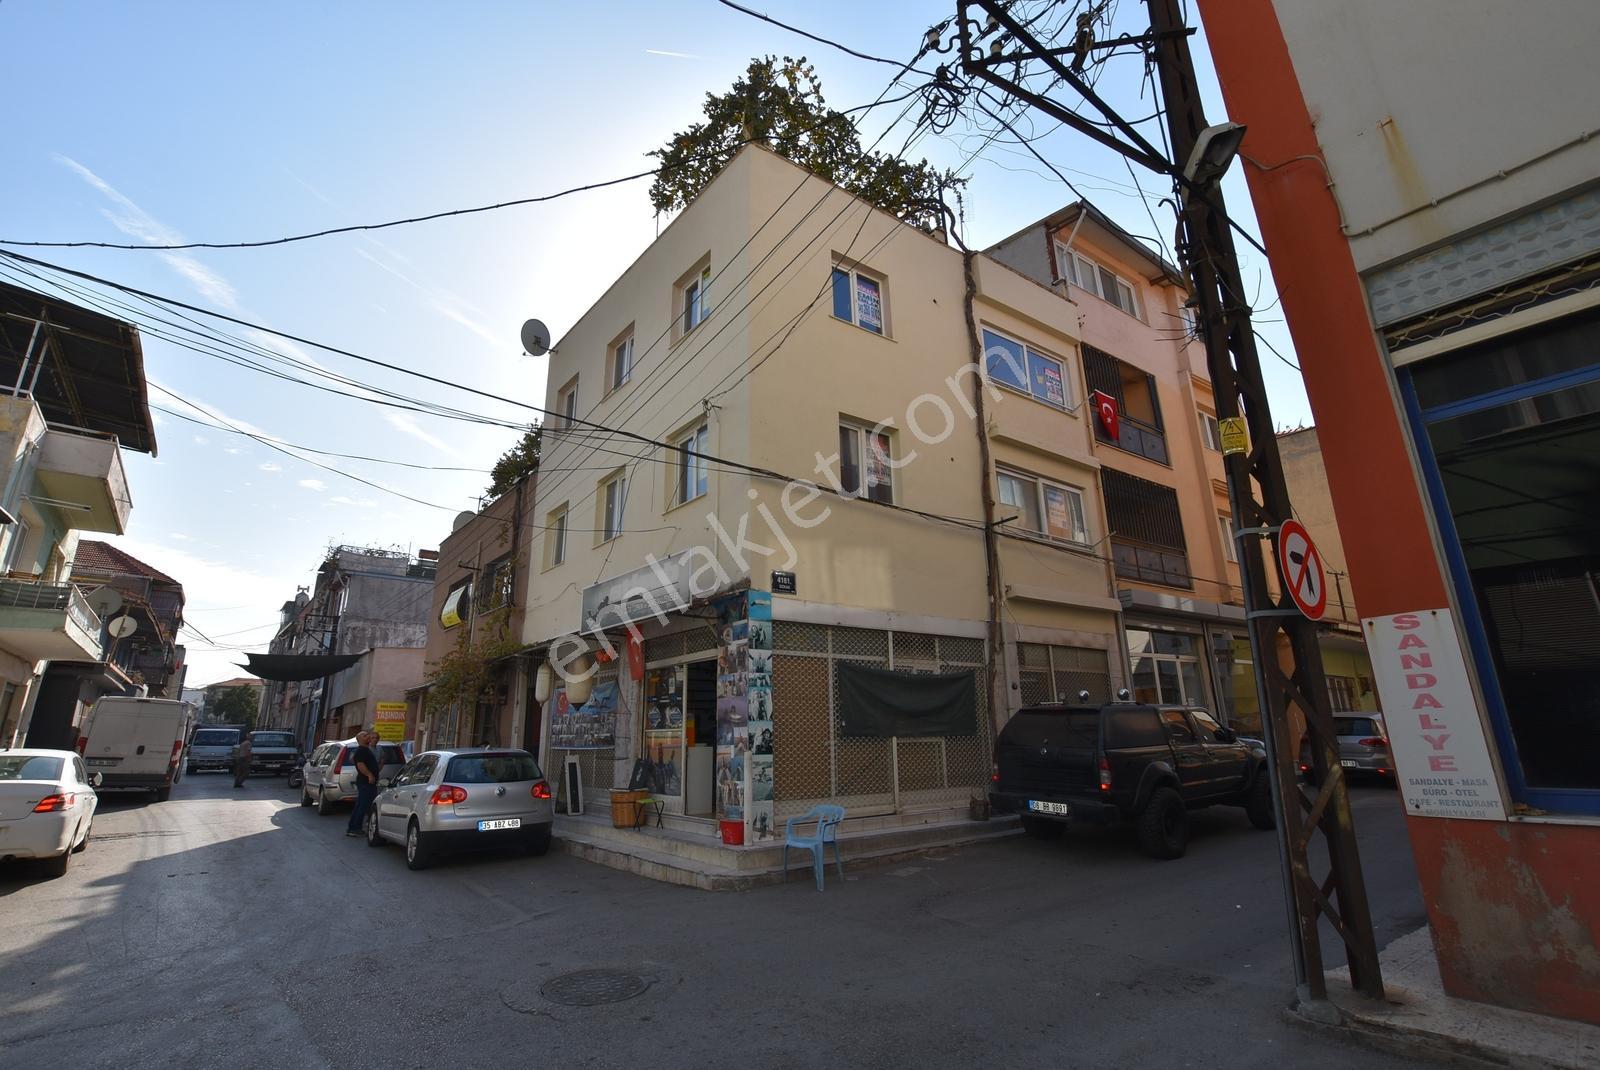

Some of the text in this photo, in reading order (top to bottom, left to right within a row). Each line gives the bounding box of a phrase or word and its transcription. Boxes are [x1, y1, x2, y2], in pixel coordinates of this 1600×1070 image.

[1392, 614, 1459, 772] SANDALYE
[1408, 778, 1454, 786] SANDALYE
[1462, 778, 1489, 786] MASA
[1422, 787, 1448, 796] BÜRO
[1455, 789, 1479, 797] OTEL
[1408, 798, 1432, 806] CAFE
[1438, 799, 1499, 808] RESTAURANT
[483, 821, 490, 830] 35
[494, 820, 506, 828] ABZ
